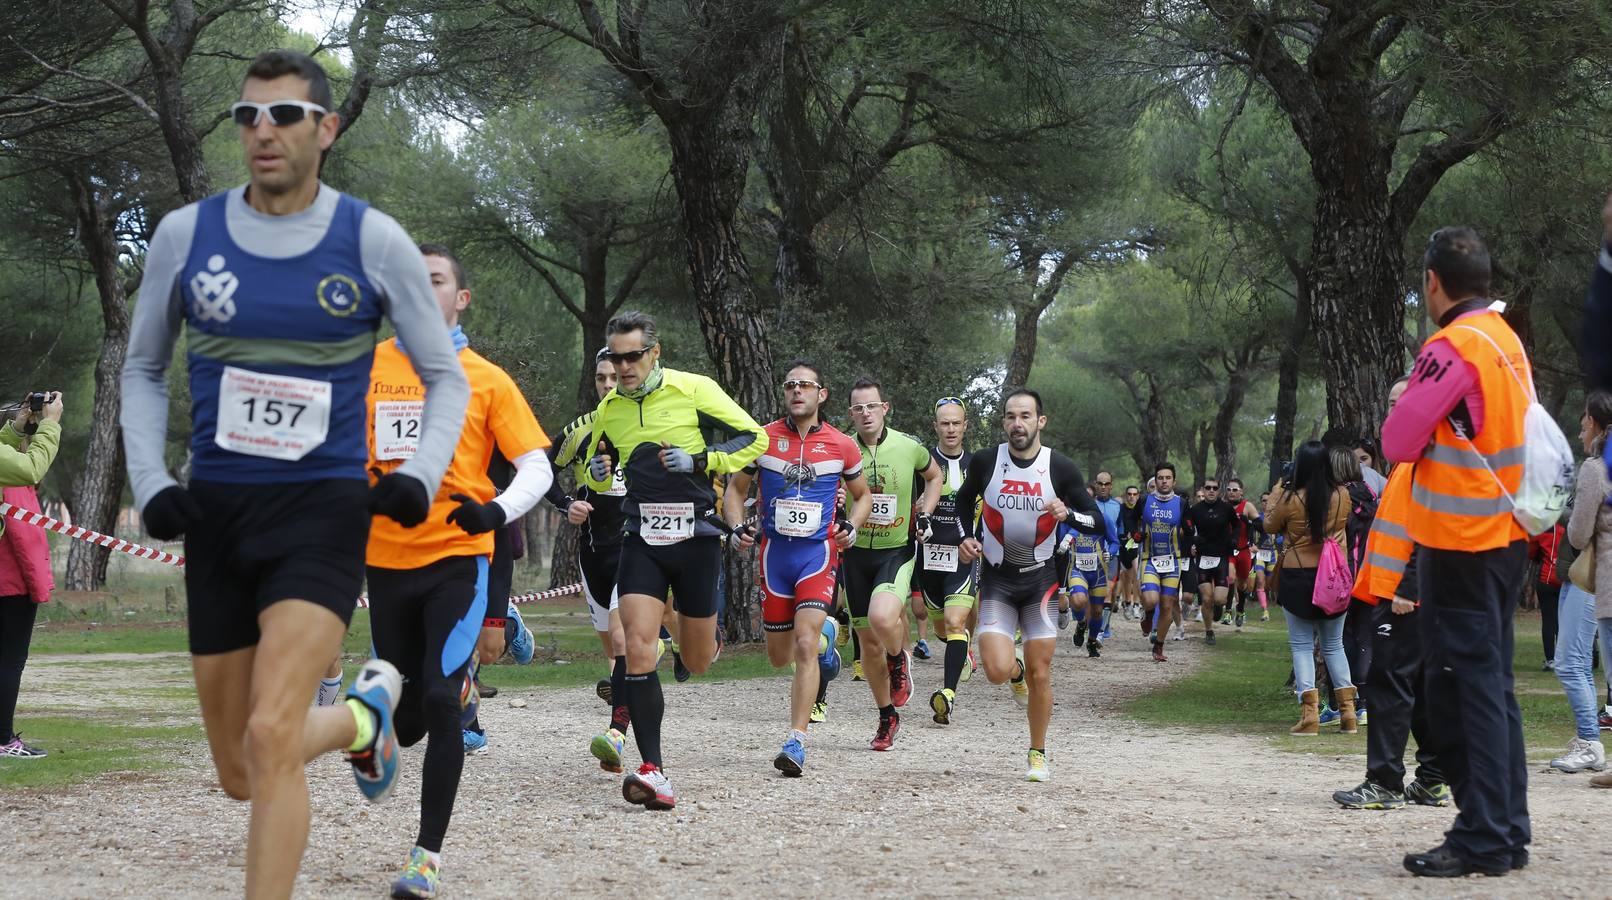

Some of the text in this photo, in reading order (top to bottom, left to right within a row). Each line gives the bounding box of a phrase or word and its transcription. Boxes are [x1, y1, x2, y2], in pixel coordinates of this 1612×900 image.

[380, 384, 421, 396] DUATL
[242, 397, 307, 428] 157
[392, 419, 419, 439] 12
[997, 494, 1045, 512] COLINO
[788, 510, 808, 524] 39
[1151, 509, 1173, 519] JESUS
[650, 515, 681, 531] 221
[930, 551, 951, 562] 271
